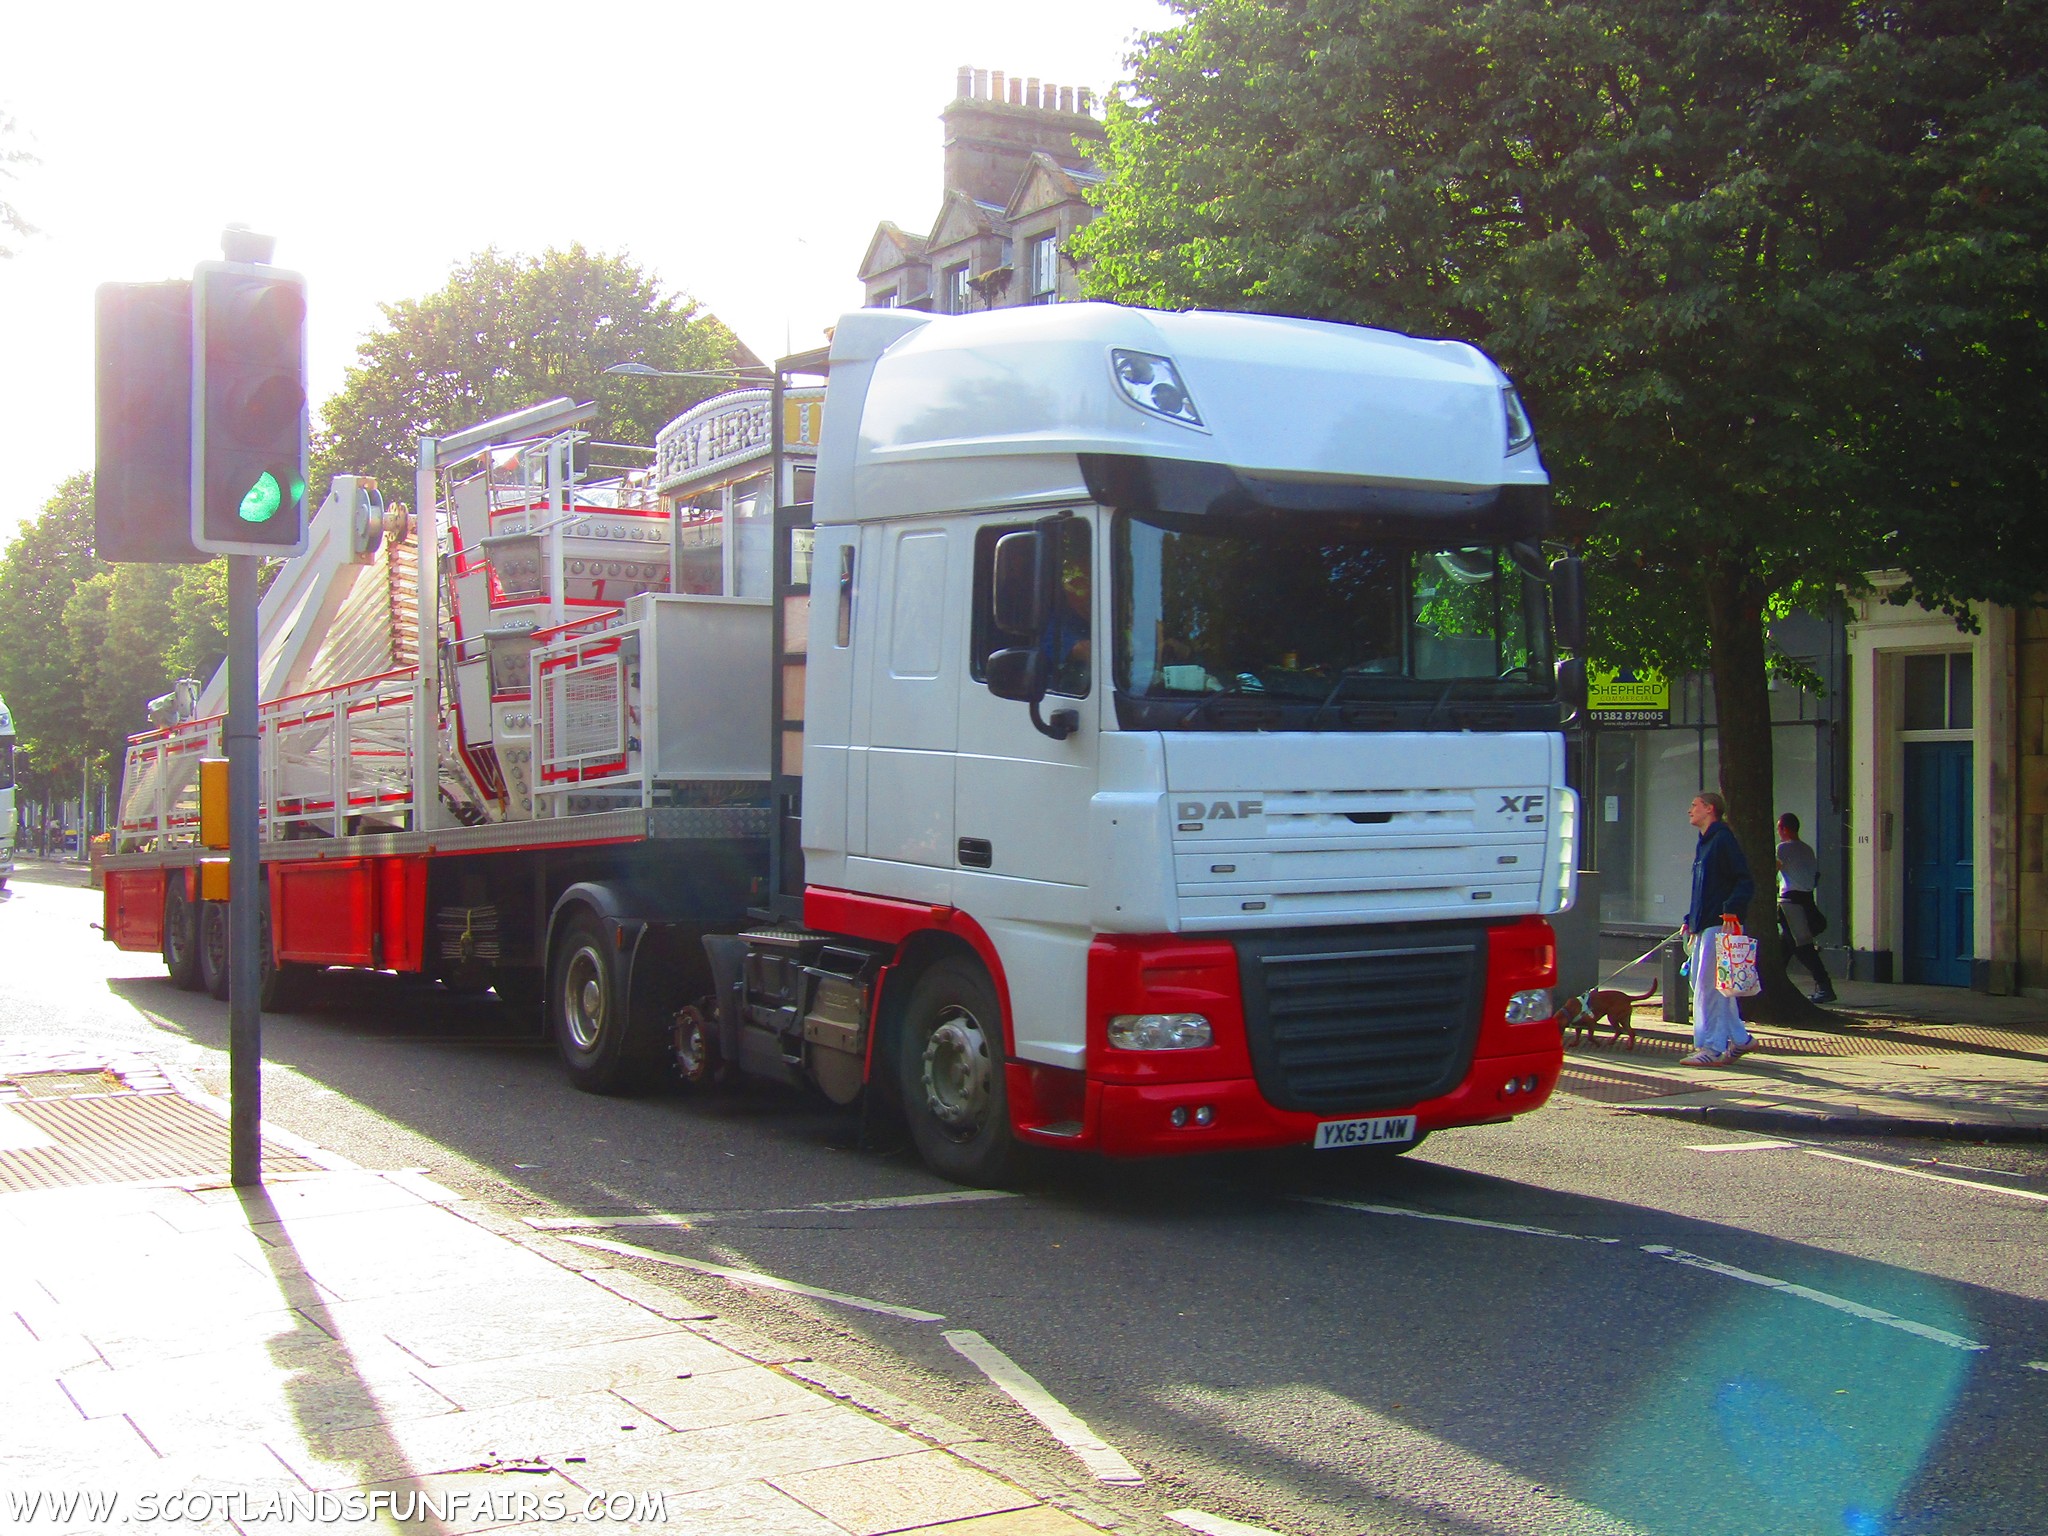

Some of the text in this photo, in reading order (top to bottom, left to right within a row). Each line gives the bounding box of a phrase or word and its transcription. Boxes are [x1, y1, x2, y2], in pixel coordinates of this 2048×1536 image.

[662, 405, 765, 477] PAY HERE
[592, 579, 606, 600] 1
[1592, 684, 1663, 695] SHEPHERD
[1590, 711, 1664, 720] 01382 878005
[1177, 800, 1263, 820] DAF
[1495, 795, 1544, 813] XF
[1858, 835, 1869, 844] 119
[1323, 1118, 1409, 1145] YX63 LNW
